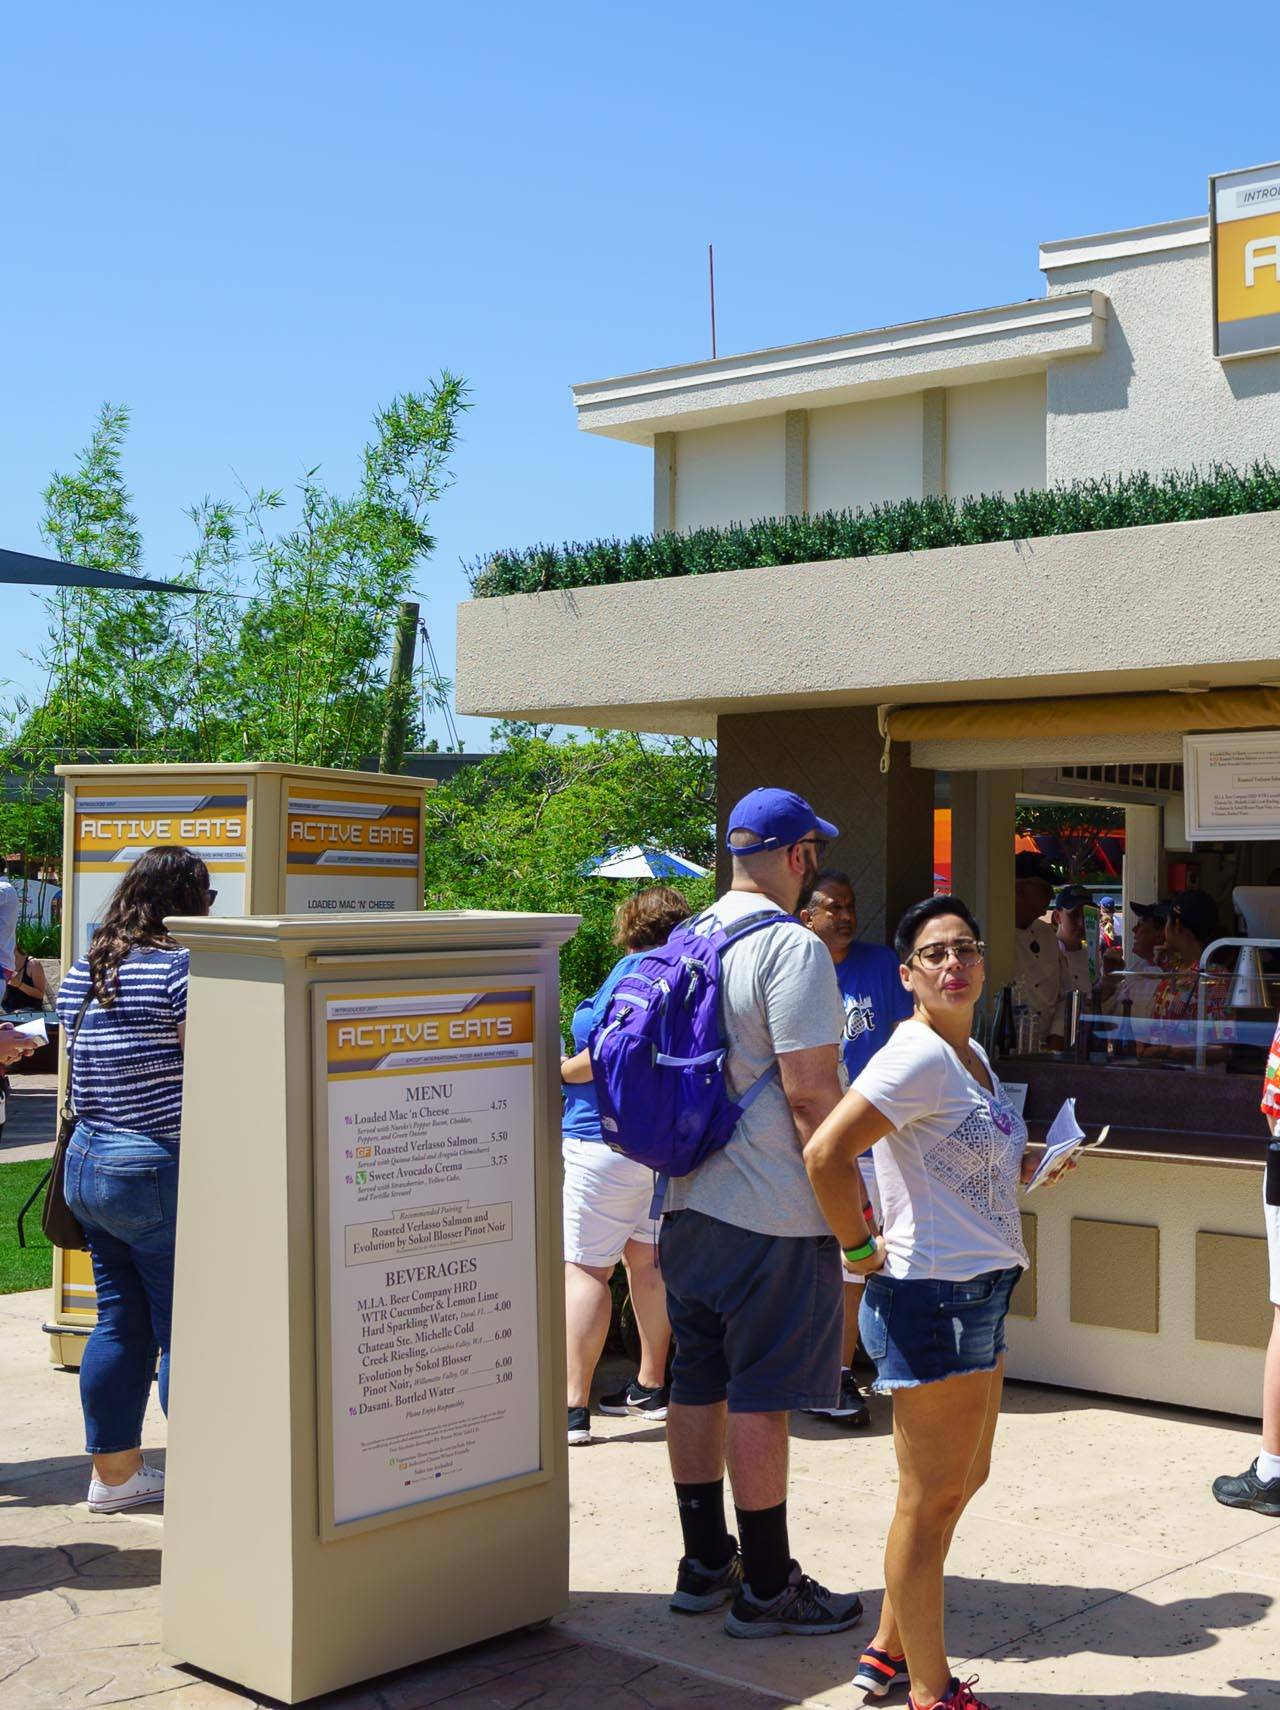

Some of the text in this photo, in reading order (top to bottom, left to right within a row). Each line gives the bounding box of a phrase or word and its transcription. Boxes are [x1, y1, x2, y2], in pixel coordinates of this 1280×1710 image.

[81, 818, 241, 838] ACTIVE EATS
[291, 821, 414, 845] ACTIVE EATS
[308, 899, 338, 909] LOADED
[339, 900, 356, 909] MAC
[369, 900, 396, 909] CHEESE
[338, 1017, 513, 1047] ACTIVE EATS
[406, 1084, 453, 1102] MENU
[355, 1111, 387, 1125] Loaded
[389, 1109, 408, 1121] Mac
[420, 1107, 449, 1118] Cheese
[490, 1099, 507, 1110] 4.75
[374, 1142, 409, 1156] Roasted
[410, 1139, 445, 1152] Verlasso
[447, 1136, 478, 1147] Salmon
[491, 1131, 508, 1142] 5.50
[369, 1171, 395, 1182] Sweet
[396, 1164, 433, 1179] Avocado
[435, 1162, 463, 1173] Crema
[491, 1155, 508, 1166] 3.75
[353, 1240, 395, 1254] Evolution
[397, 1237, 406, 1250] by
[408, 1232, 431, 1245] Sokol
[434, 1229, 463, 1242] Blosser
[464, 1226, 486, 1236] Pinot
[487, 1222, 506, 1233] Noir
[372, 1211, 489, 1238] Roasted Verlasso Salmon and
[385, 1257, 477, 1287] BEVERAGES
[362, 1292, 499, 1323] WTR Cucumber & Lemon Lime
[390, 1294, 410, 1305] Beer
[411, 1288, 452, 1301] Company
[454, 1280, 478, 1293] HRD
[362, 1323, 385, 1337] Hard
[387, 1318, 429, 1335] Sparkling
[430, 1313, 458, 1324] Water,
[494, 1300, 511, 1312] 4.00
[358, 1321, 474, 1354] Chateau Ste. Michelle Cold
[362, 1353, 388, 1367] Creek
[391, 1347, 429, 1362] Riesling,
[495, 1328, 512, 1341] 6.00
[358, 1353, 472, 1385] Evolution by Sokol Blosser
[363, 1385, 387, 1397] Pinot
[389, 1379, 412, 1392] Noir,
[495, 1356, 513, 1368] 6.00
[395, 1389, 427, 1407] Bottled
[429, 1386, 455, 1398] Water
[496, 1371, 513, 1384] 3.00
